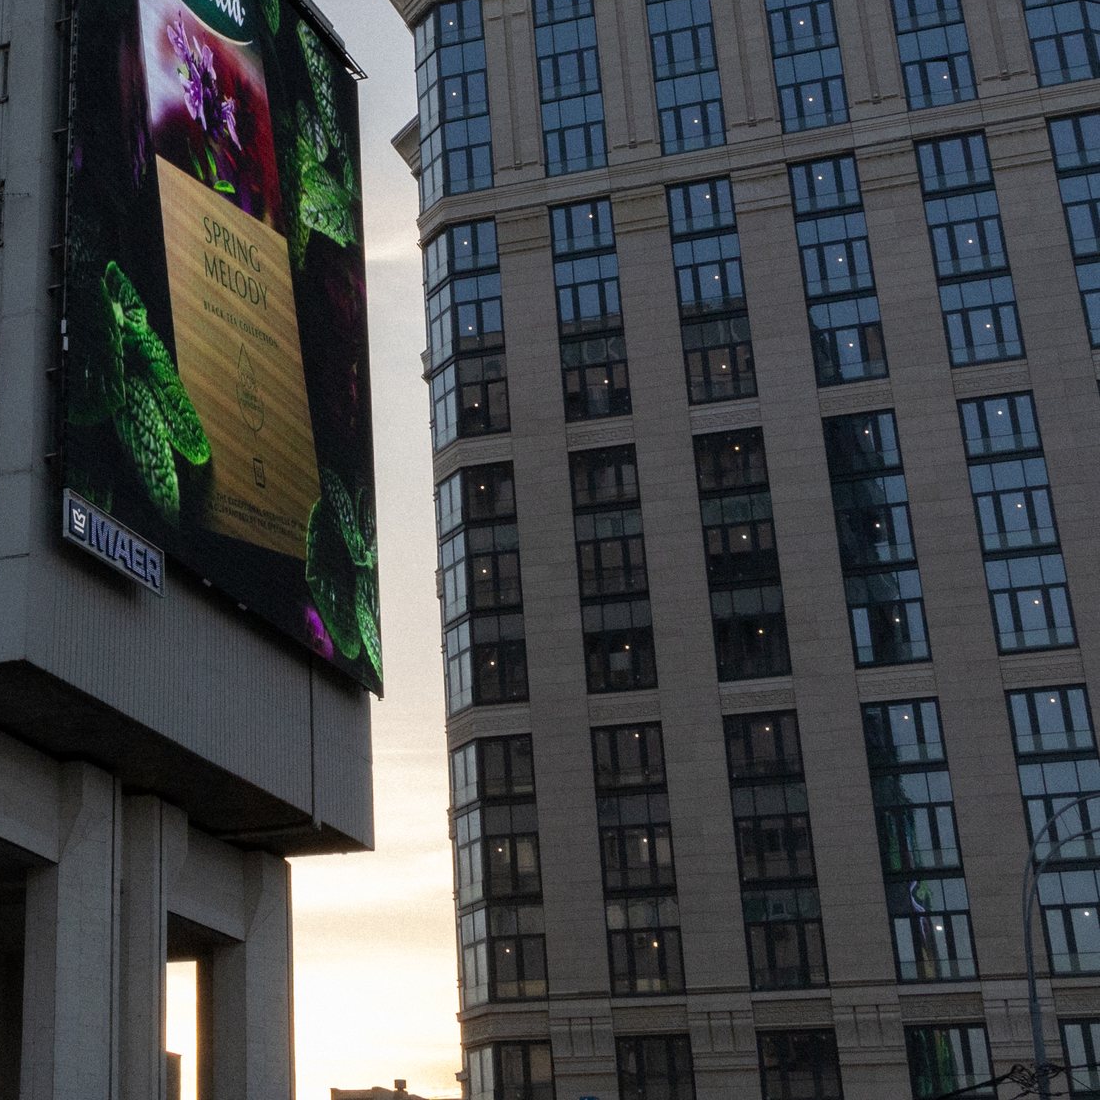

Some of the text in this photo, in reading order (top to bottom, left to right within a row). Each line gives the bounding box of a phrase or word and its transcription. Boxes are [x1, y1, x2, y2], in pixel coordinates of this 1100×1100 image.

[203, 216, 260, 273] SPRING
[204, 251, 267, 311] MELODY
[203, 299, 224, 319] BLACK
[239, 319, 279, 348] COLLECTION
[89, 512, 161, 589] MAER
